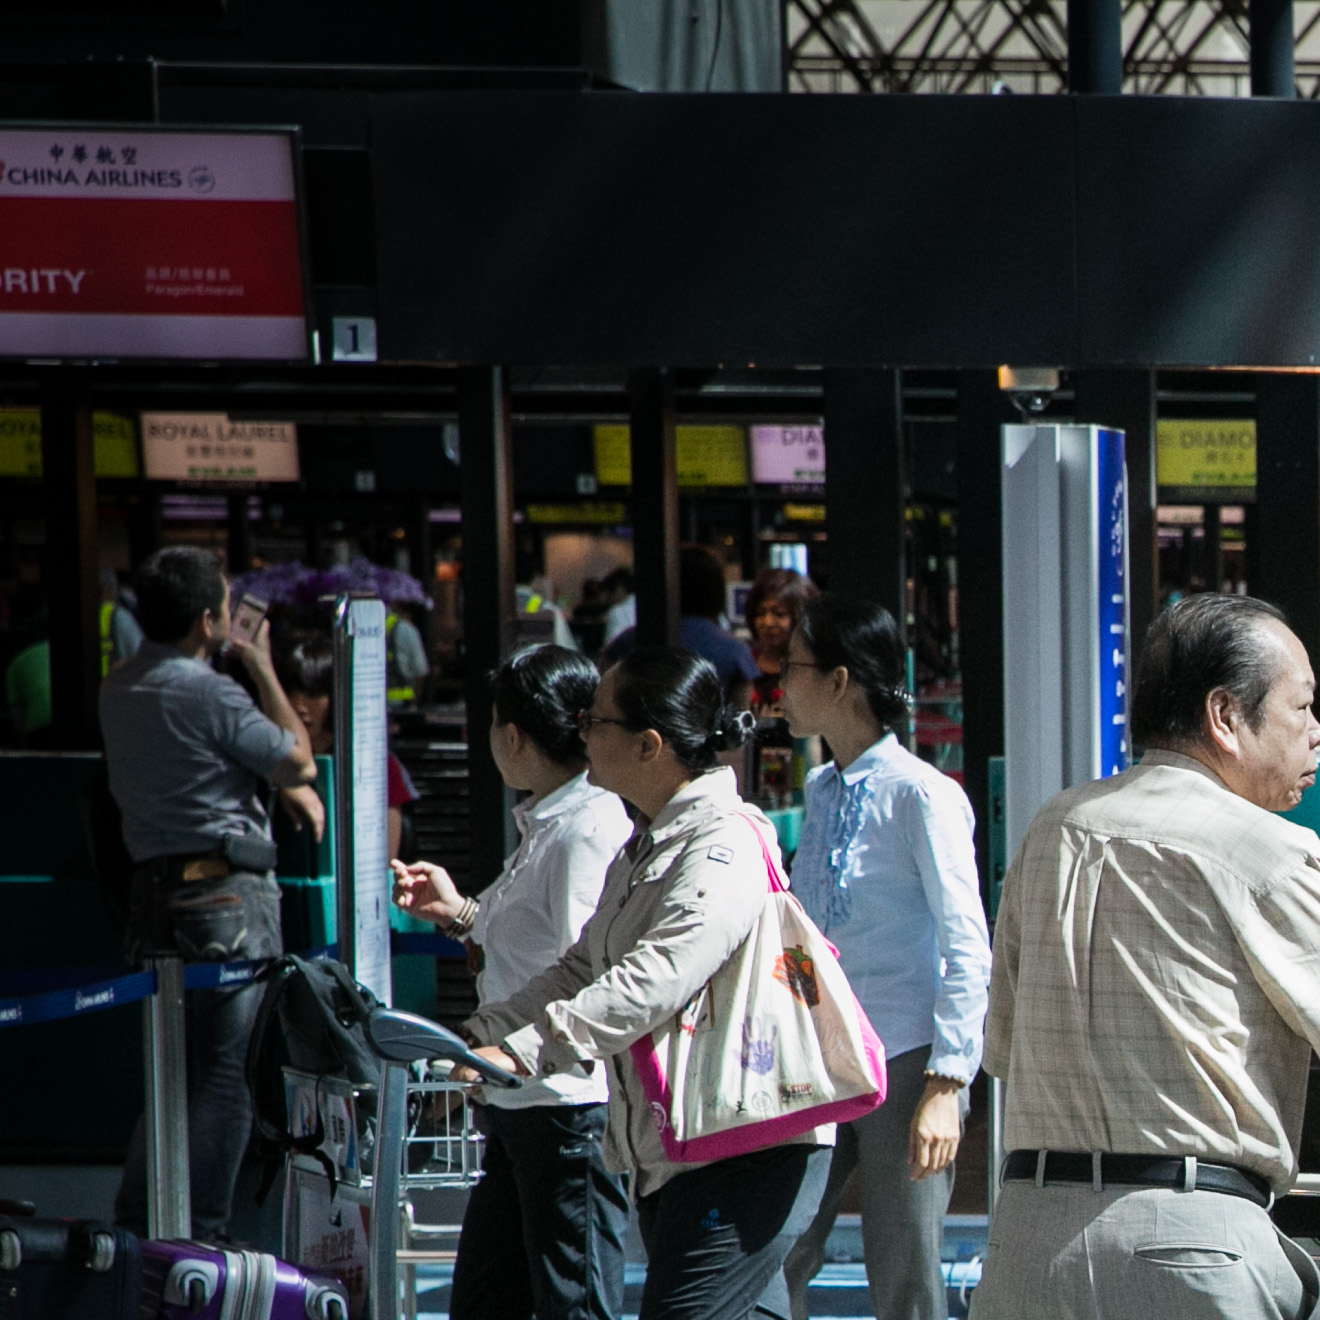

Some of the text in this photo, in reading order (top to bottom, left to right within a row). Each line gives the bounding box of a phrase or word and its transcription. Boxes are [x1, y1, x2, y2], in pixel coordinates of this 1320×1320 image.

[50, 143, 138, 165] 中華航空
[7, 167, 182, 188] CHINA AIRLINES
[345, 324, 359, 356] 1
[790, 1083, 812, 1094] STOP
